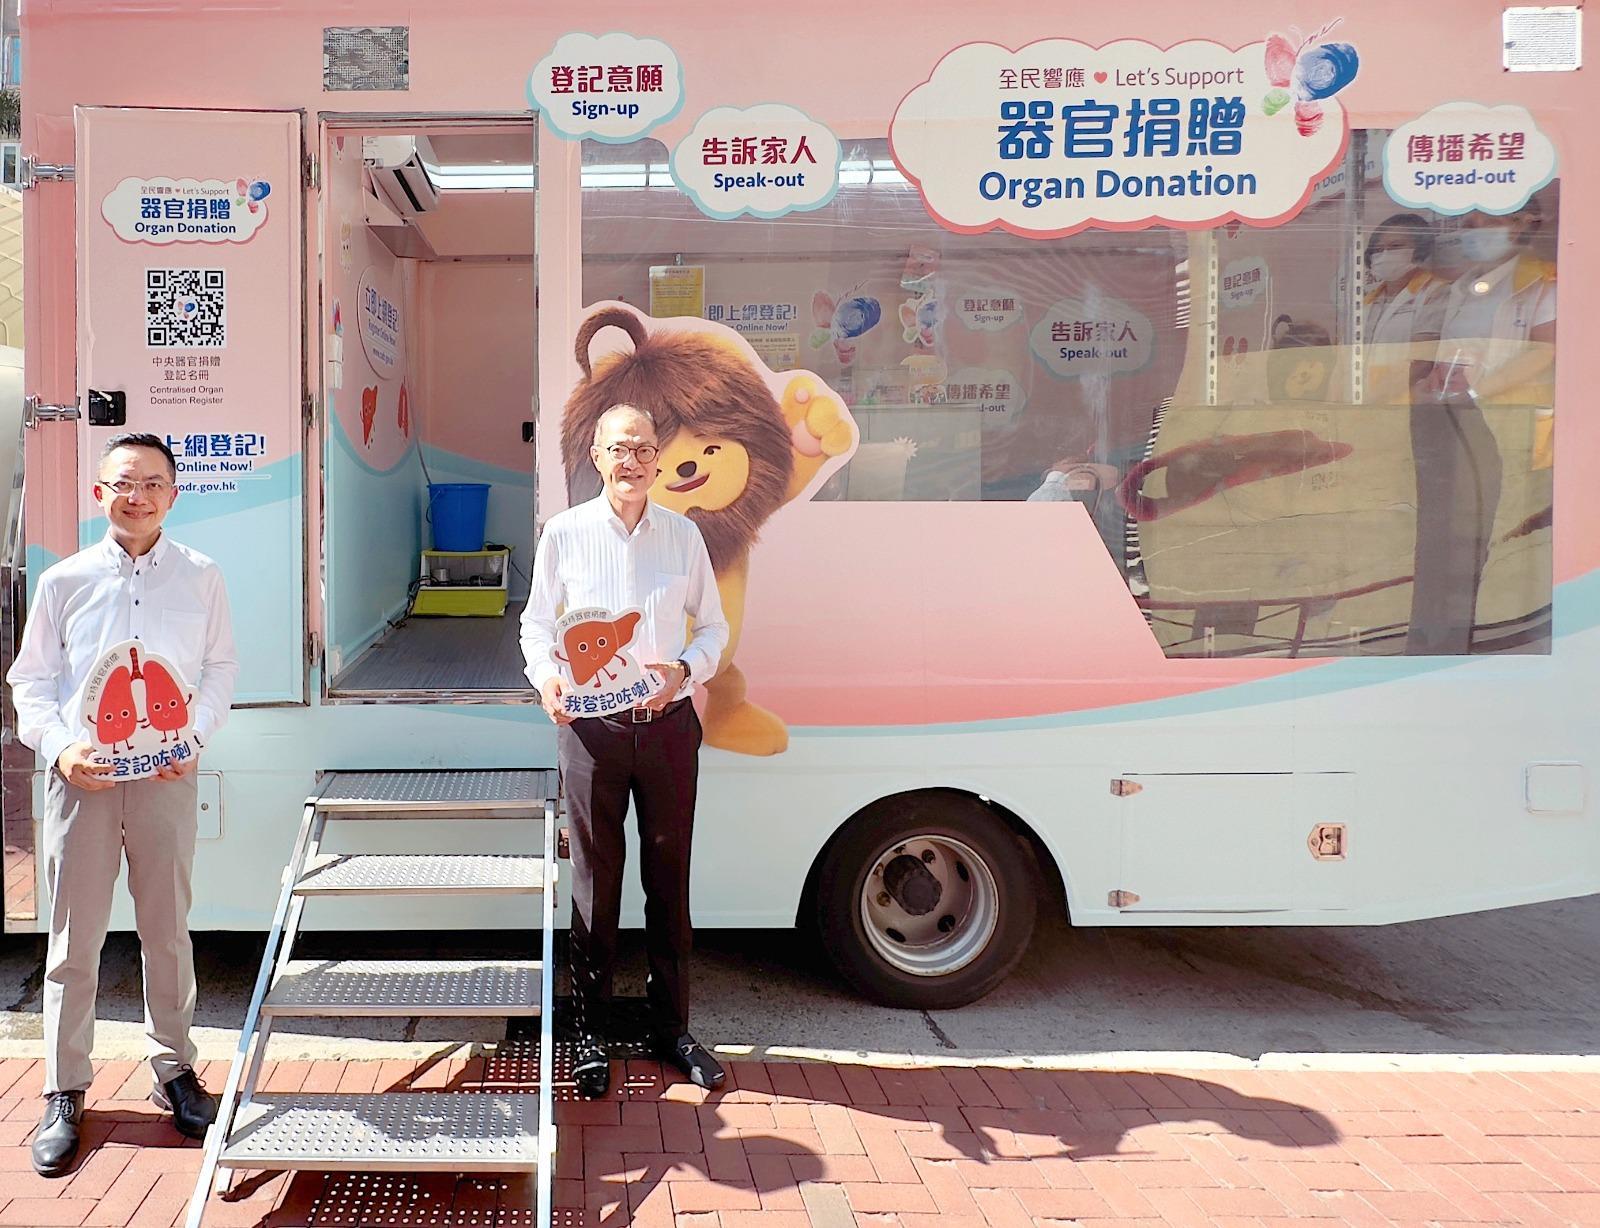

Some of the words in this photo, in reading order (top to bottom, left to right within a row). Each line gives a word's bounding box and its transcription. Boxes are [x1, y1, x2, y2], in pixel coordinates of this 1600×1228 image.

[550, 64, 664, 94] 登記意願
[999, 67, 1086, 90] 全民響應
[1116, 67, 1160, 87] Let’s
[1165, 67, 1245, 90] Support
[572, 101, 639, 120] Sign-up
[997, 96, 1246, 160] 器官捐贈
[702, 136, 817, 166] 告訴家人
[1407, 132, 1525, 163] 傳播希望
[714, 171, 805, 192] Speak-out
[979, 171, 1085, 208] Organ
[1096, 165, 1257, 198] Donation
[1414, 168, 1517, 190] Spread-out
[201, 188, 229, 196] Support
[141, 198, 230, 220] 器官捐贈
[135, 222, 174, 236] Organ
[177, 222, 236, 234] Donation
[705, 304, 797, 321] 即上網登記!
[974, 313, 1004, 323] Sign-up
[737, 323, 763, 332] Online
[765, 322, 788, 331] Now!
[152, 356, 221, 367] 中央器官捐贈
[164, 369, 209, 381] 登記名冊
[150, 386, 196, 394] Centralised
[198, 386, 224, 395] Organ
[150, 396, 187, 405] Donation
[189, 396, 223, 406] Register
[176, 461, 217, 473] Online
[220, 460, 252, 472] Now!
[178, 481, 237, 494] odr.gov.hk
